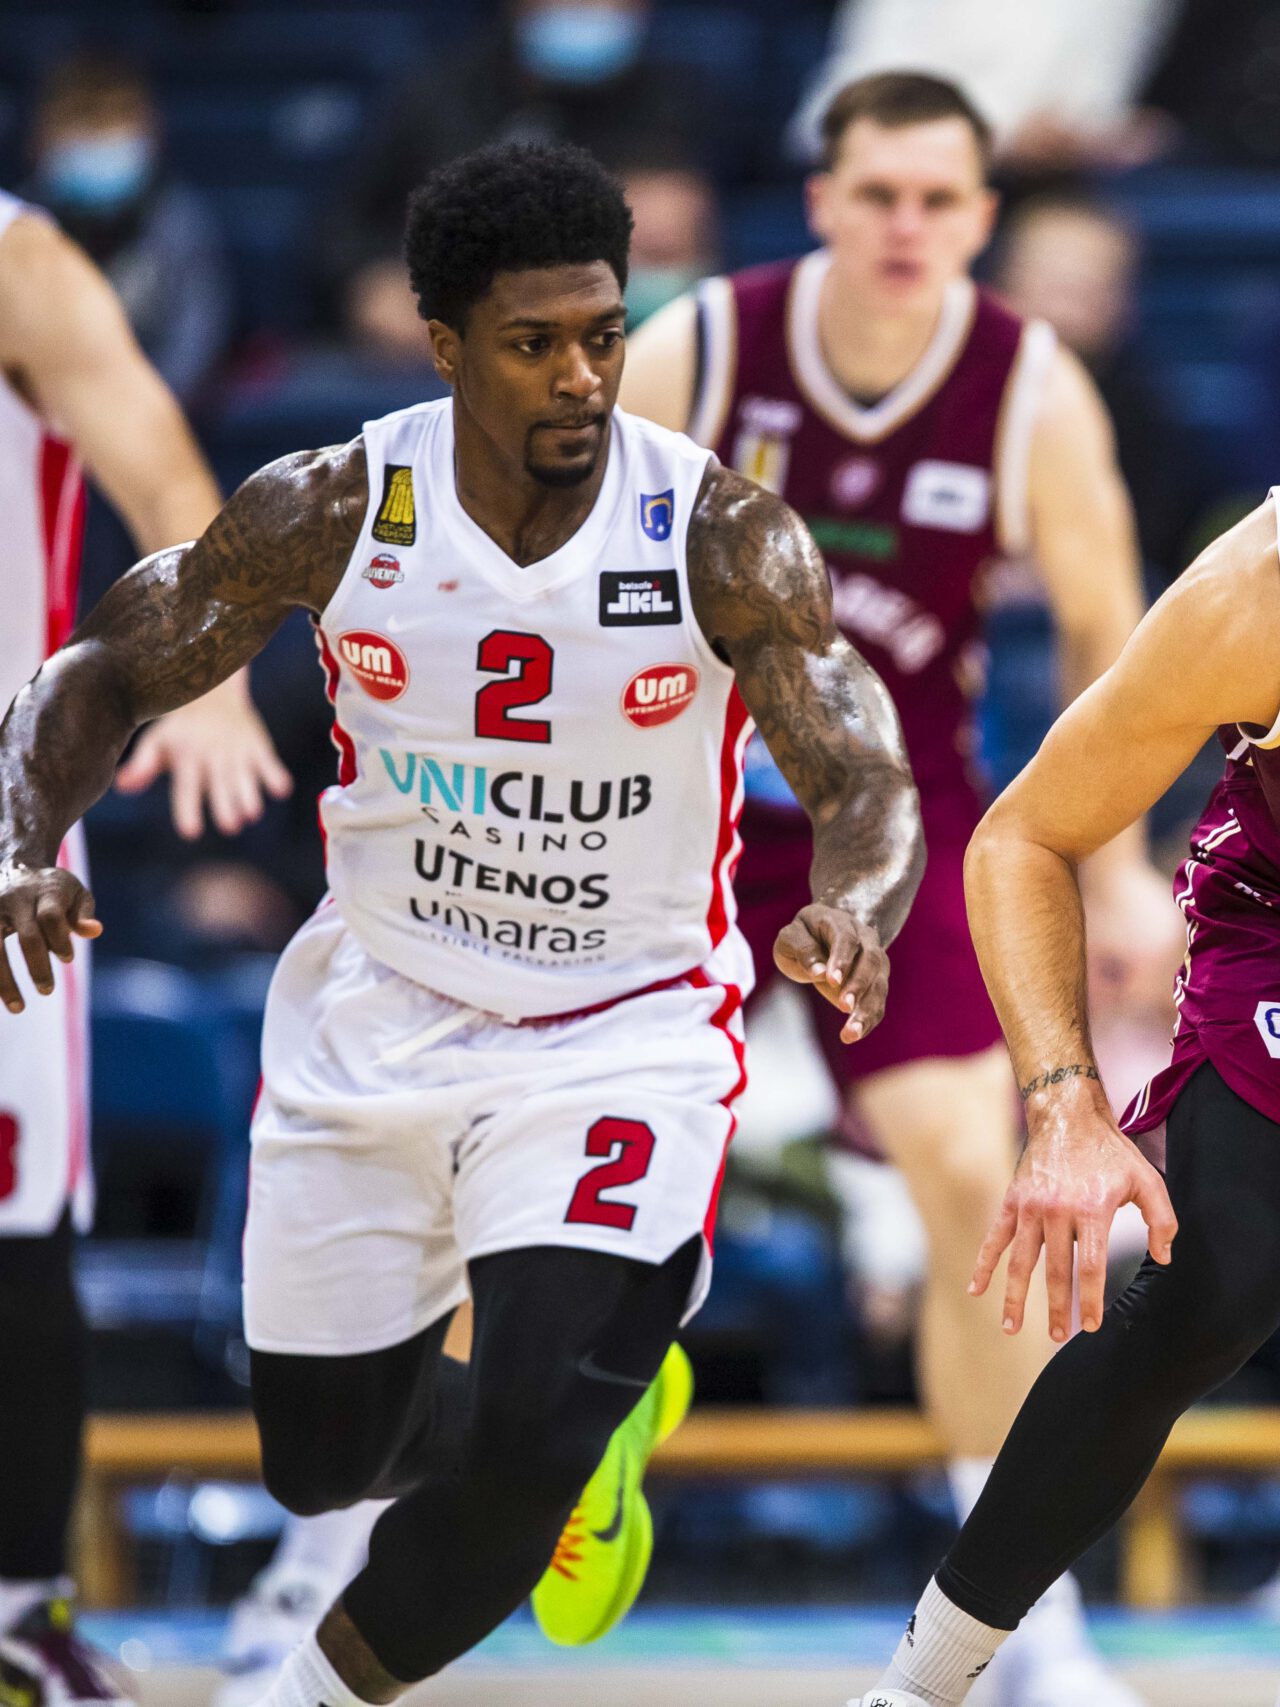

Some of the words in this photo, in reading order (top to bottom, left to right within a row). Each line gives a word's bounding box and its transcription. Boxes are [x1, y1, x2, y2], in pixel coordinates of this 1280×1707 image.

[607, 591, 673, 614] JKL
[475, 629, 554, 744] 2
[378, 747, 652, 823] UNICLUB
[421, 806, 608, 852] CASINO
[415, 838, 610, 910] UTENOS
[563, 1114, 657, 1232] 2
